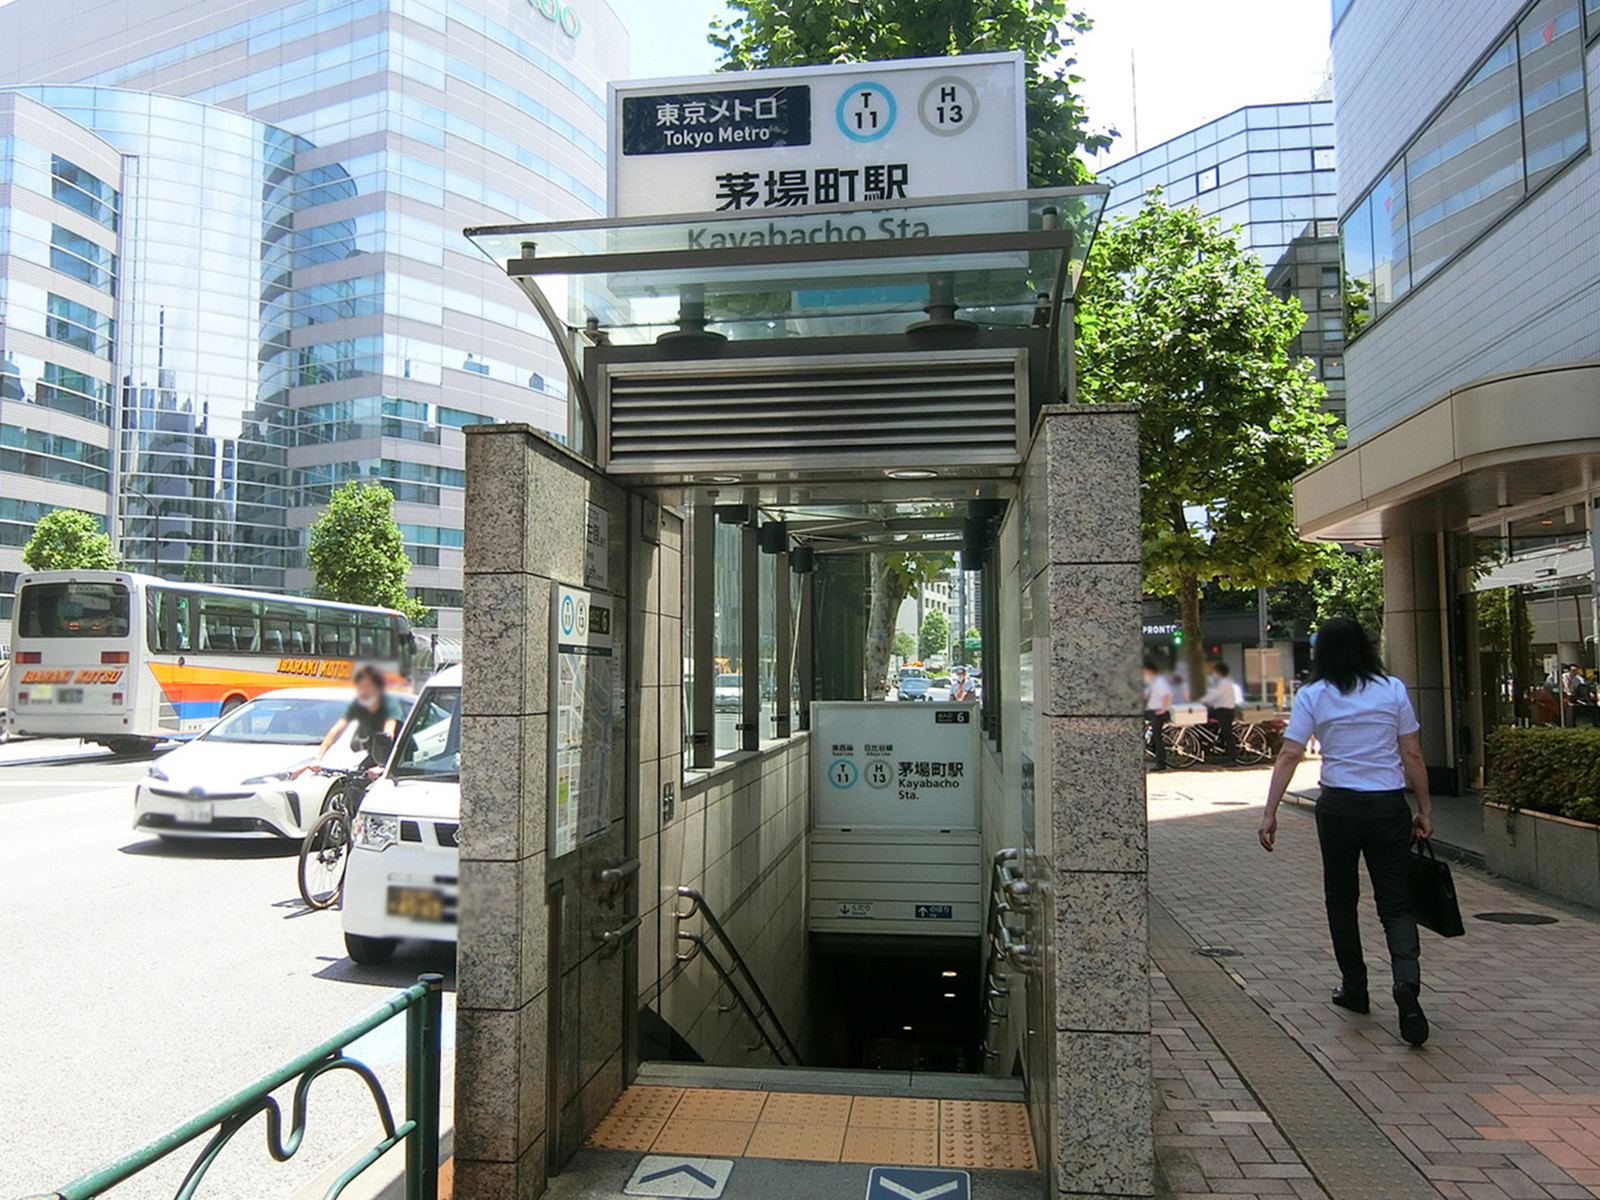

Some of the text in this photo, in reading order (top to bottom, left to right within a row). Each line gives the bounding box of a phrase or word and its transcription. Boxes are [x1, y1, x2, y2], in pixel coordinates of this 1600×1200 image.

[528, 0, 581, 38] ao
[860, 92, 872, 108] T
[940, 86, 956, 103] H
[656, 98, 777, 126] 東京メトロ
[855, 111, 877, 129] 11
[936, 105, 963, 123] 13
[663, 126, 770, 148] Tokyo Metro
[715, 164, 908, 212] 茅場町駅
[276, 657, 319, 676] IBARAKI
[21, 670, 123, 684] IBARAKI KOTSU
[957, 712, 965, 722] 6
[840, 764, 846, 772] T
[875, 764, 883, 773] H
[898, 761, 964, 777] 茅場町駅
[837, 773, 849, 783] 11
[873, 773, 886, 783] 13
[898, 778, 960, 790] Kayabacho
[898, 790, 919, 800] Sta.
